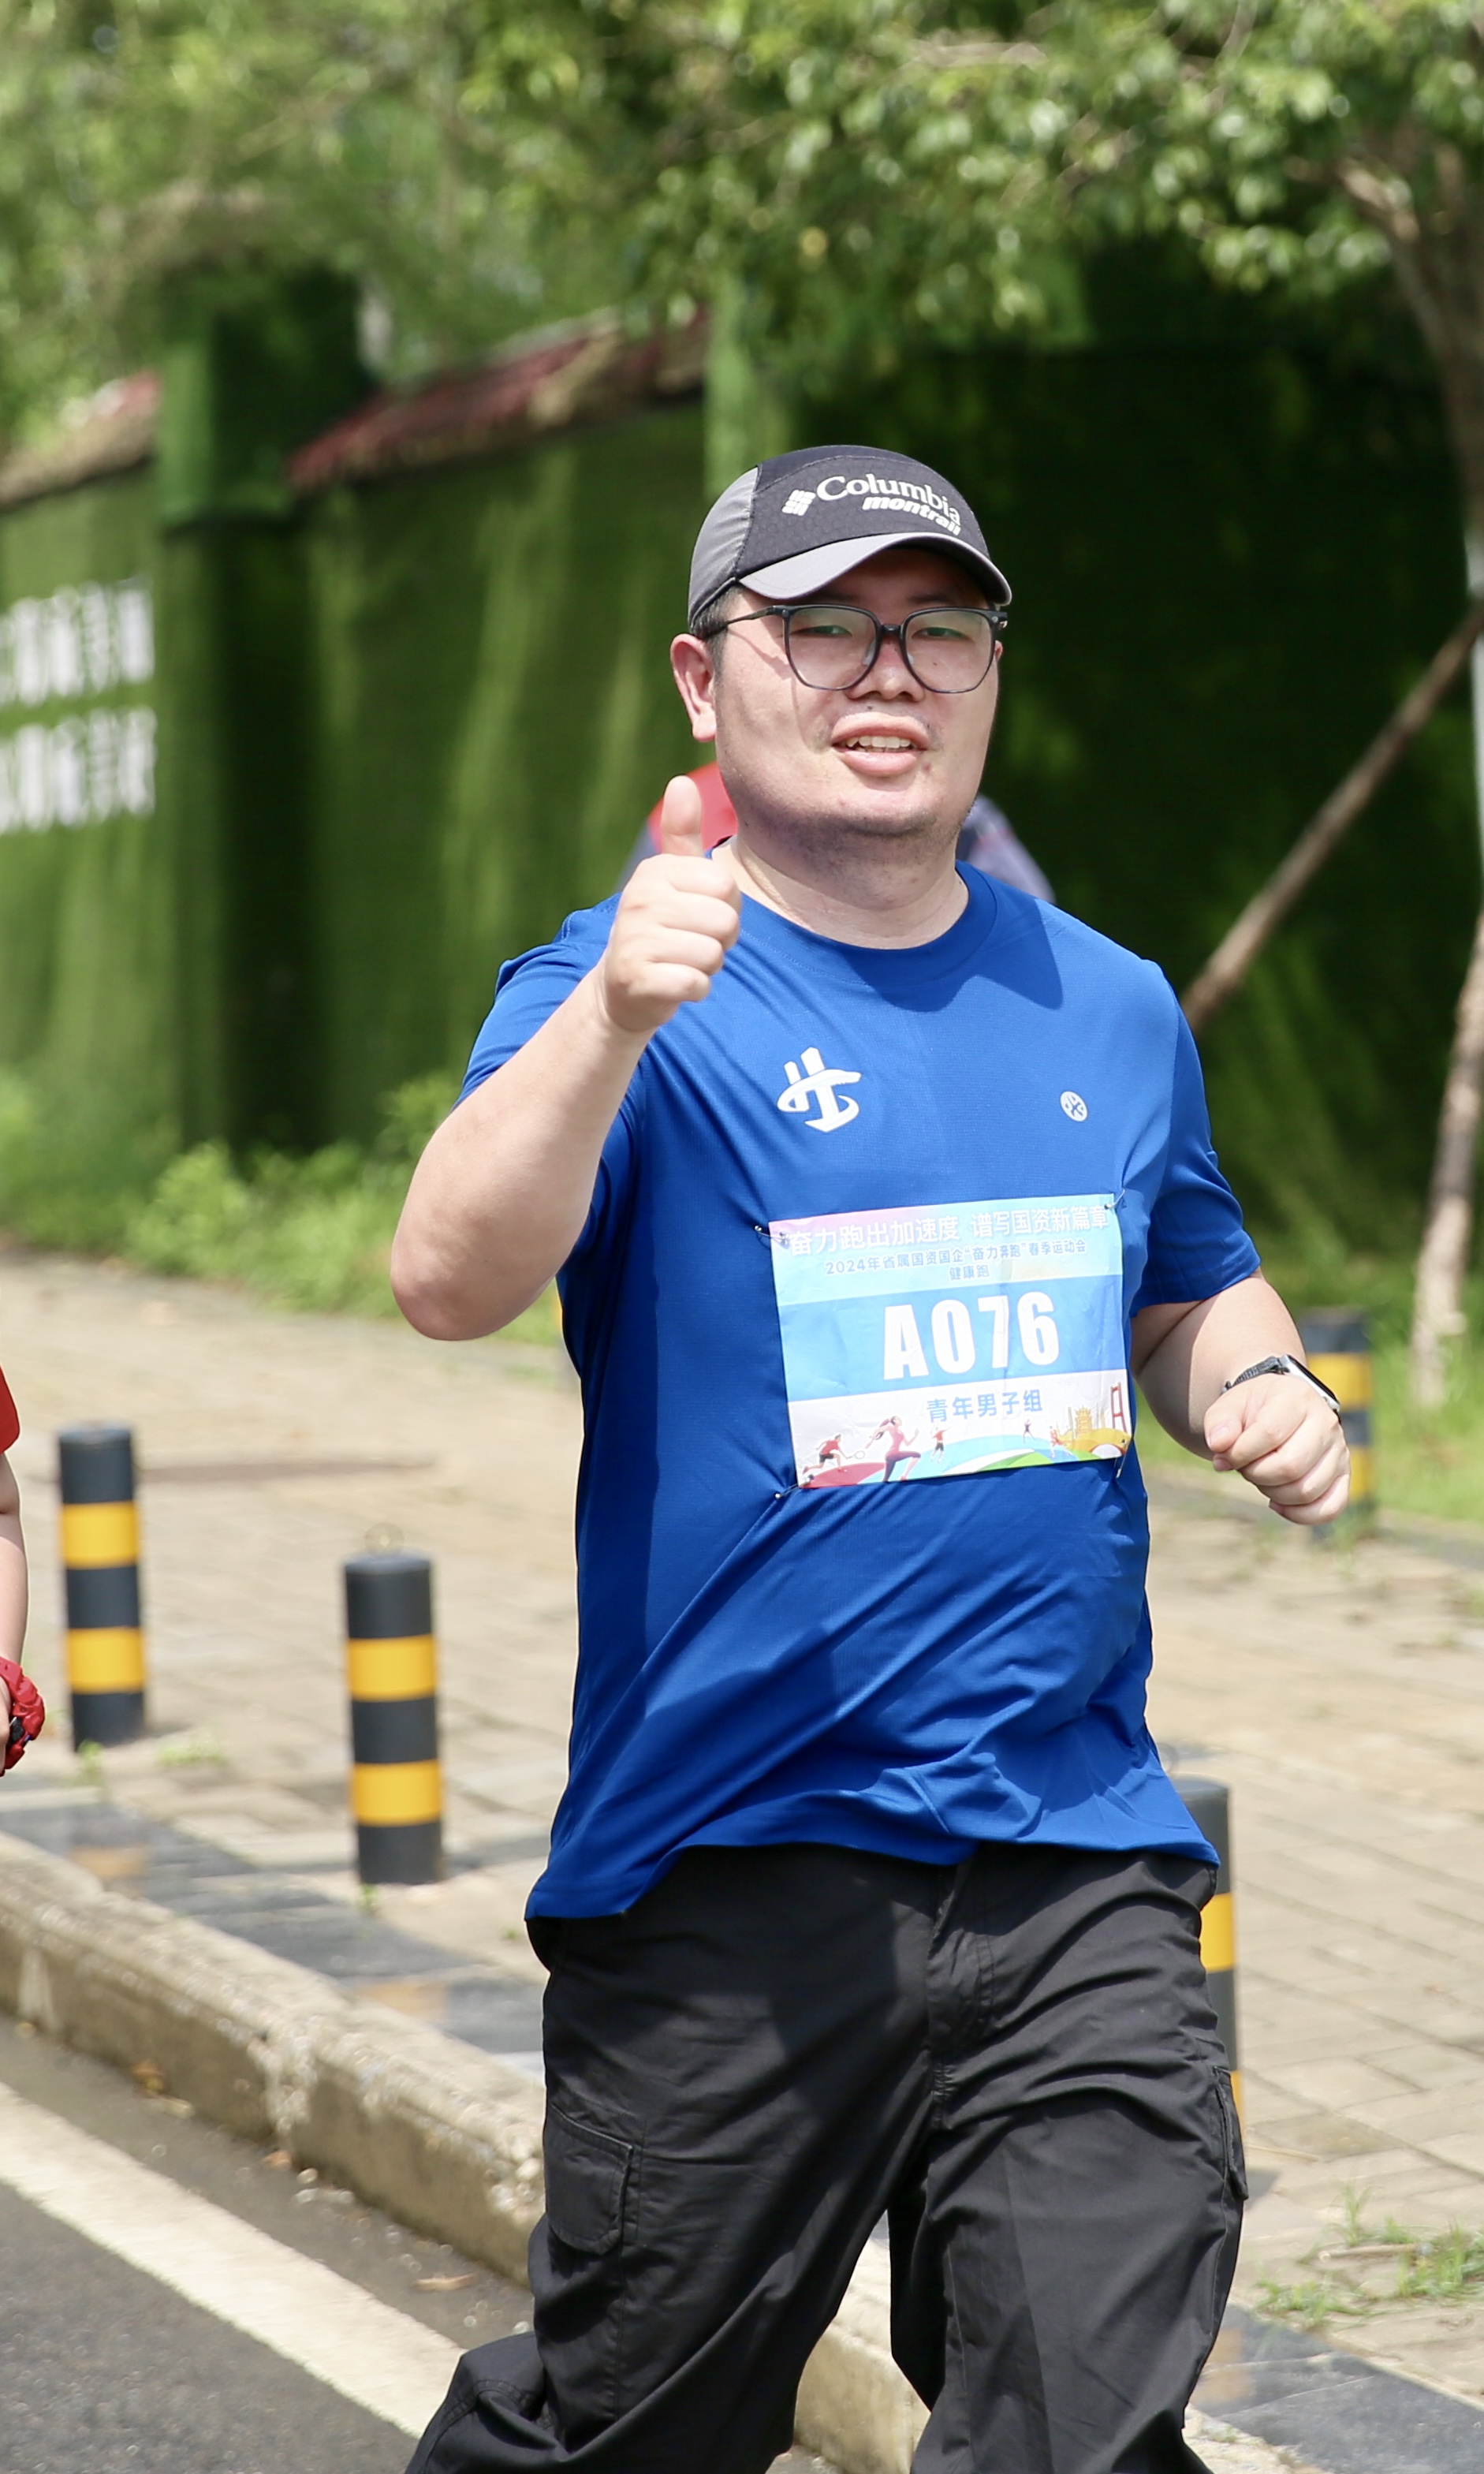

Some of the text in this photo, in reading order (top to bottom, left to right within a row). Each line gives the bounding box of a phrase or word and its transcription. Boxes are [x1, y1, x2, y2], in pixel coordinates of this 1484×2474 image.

[816, 473, 960, 525] Columbia
[862, 497, 961, 535] montrail
[789, 1206, 1109, 1256] 奋力跑出加速度 谱写国资新篇章
[949, 1264, 990, 1281] 健康跑
[883, 1292, 1059, 1380] A076
[927, 1389, 1043, 1423] 青年男子组
